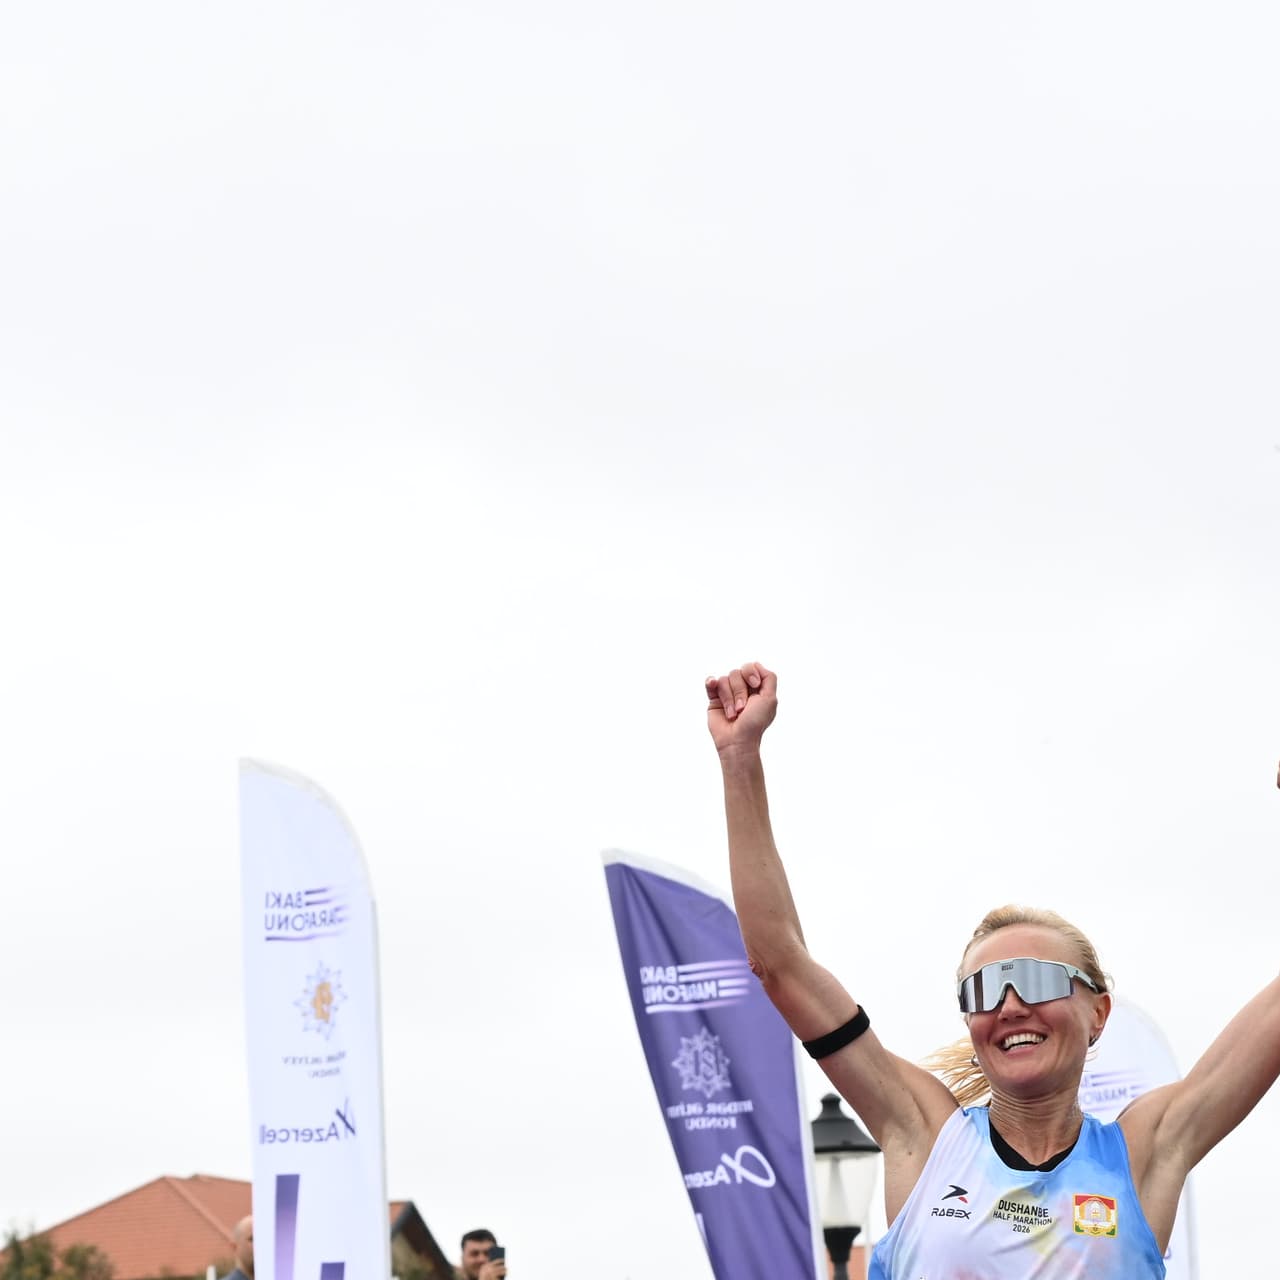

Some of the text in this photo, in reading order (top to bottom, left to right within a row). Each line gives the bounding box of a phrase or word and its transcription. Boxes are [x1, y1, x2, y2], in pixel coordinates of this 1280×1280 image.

[998, 1199, 1049, 1218] DUSHANBE
[992, 1211, 1053, 1226] HALF MARATHON
[1012, 1223, 1031, 1234] 2026
